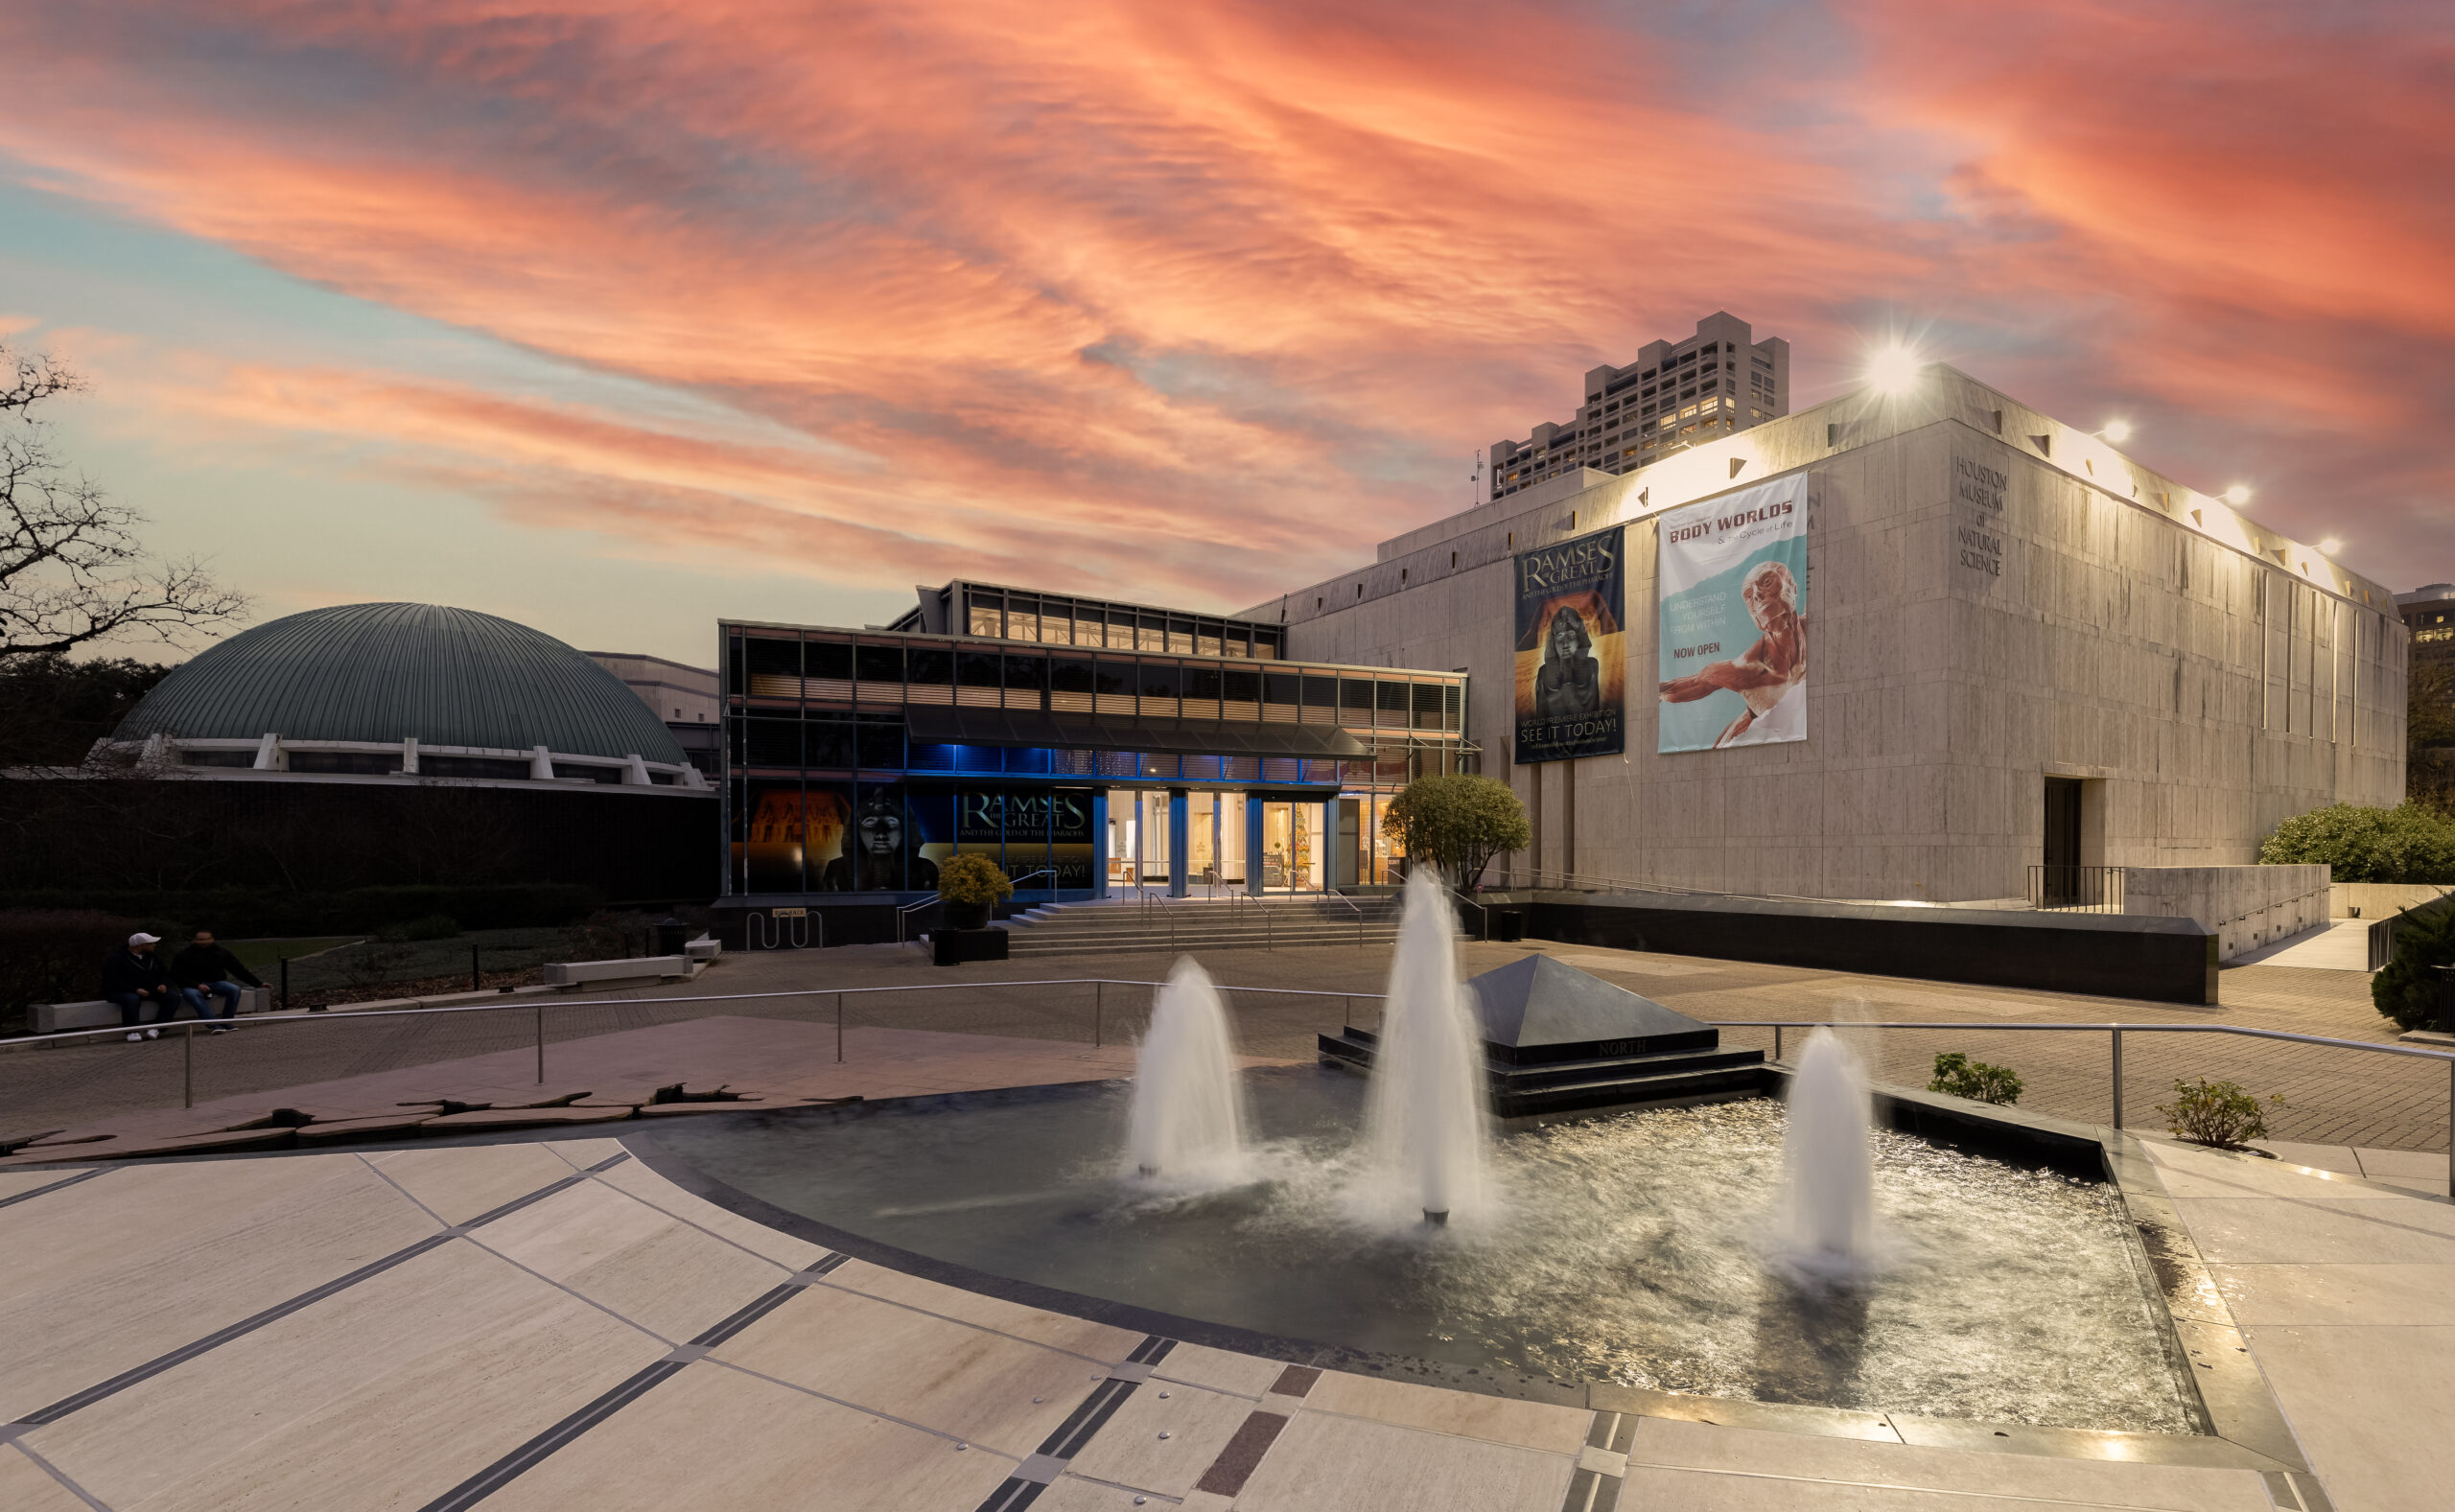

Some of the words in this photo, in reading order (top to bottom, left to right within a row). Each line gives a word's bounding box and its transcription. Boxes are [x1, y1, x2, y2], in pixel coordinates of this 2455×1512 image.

[1957, 455, 2007, 491] HOUSTON
[1959, 481, 2002, 511] MUSEUM
[1670, 522, 1712, 545] BODY
[1718, 500, 1793, 531] WORLDS
[1740, 527, 1765, 539] Cycle
[1774, 520, 1793, 530] Life
[1976, 513, 1986, 527] of
[1958, 525, 2002, 555] NATURAL
[1523, 535, 1615, 593] RAMSES
[1550, 561, 1597, 584] GREAT
[1960, 549, 2000, 576] SCIENCE
[1670, 592, 1726, 612] UNDERSTAND
[1682, 604, 1726, 620] YOURSELF
[1696, 616, 1726, 629] WITHIN
[1673, 645, 1695, 659] NOW
[1697, 641, 1720, 656] OPEN
[1521, 728, 1543, 742] SEE
[1548, 726, 1560, 739] IT
[1564, 718, 1617, 737] TODAY!
[962, 791, 1086, 828] RAMSES
[1004, 813, 1064, 827] GREAT
[1025, 865, 1086, 877] TODAY!
[1599, 1040, 1647, 1058] NORTH
